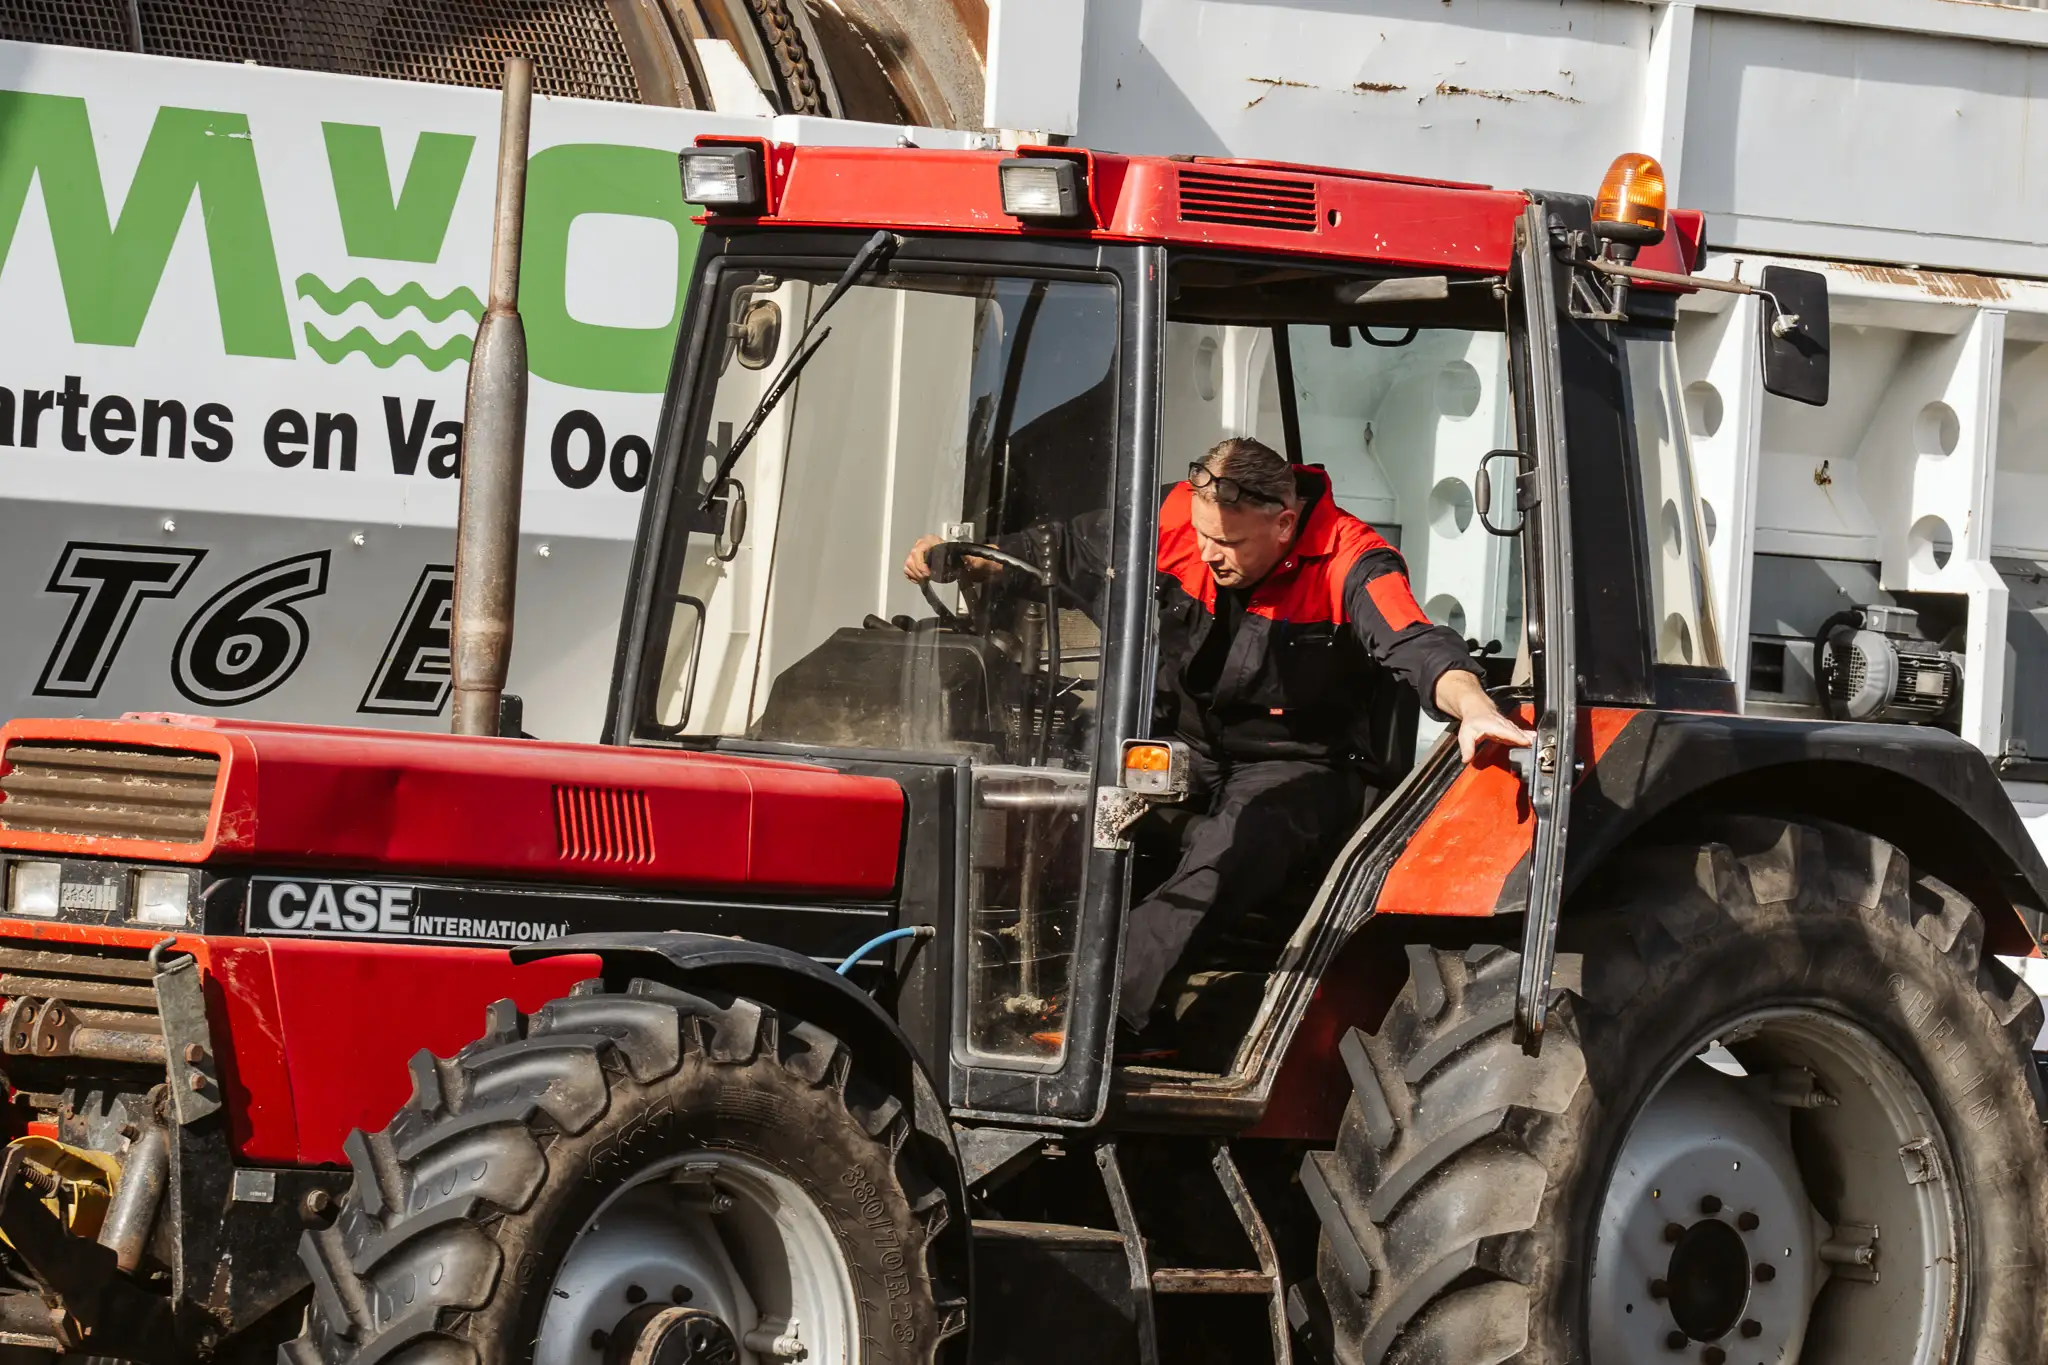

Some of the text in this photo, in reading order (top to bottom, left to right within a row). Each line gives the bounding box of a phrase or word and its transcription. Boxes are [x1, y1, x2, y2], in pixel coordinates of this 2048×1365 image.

[263, 408, 357, 472] en
[382, 396, 465, 479] Va
[267, 882, 413, 933] CASE
